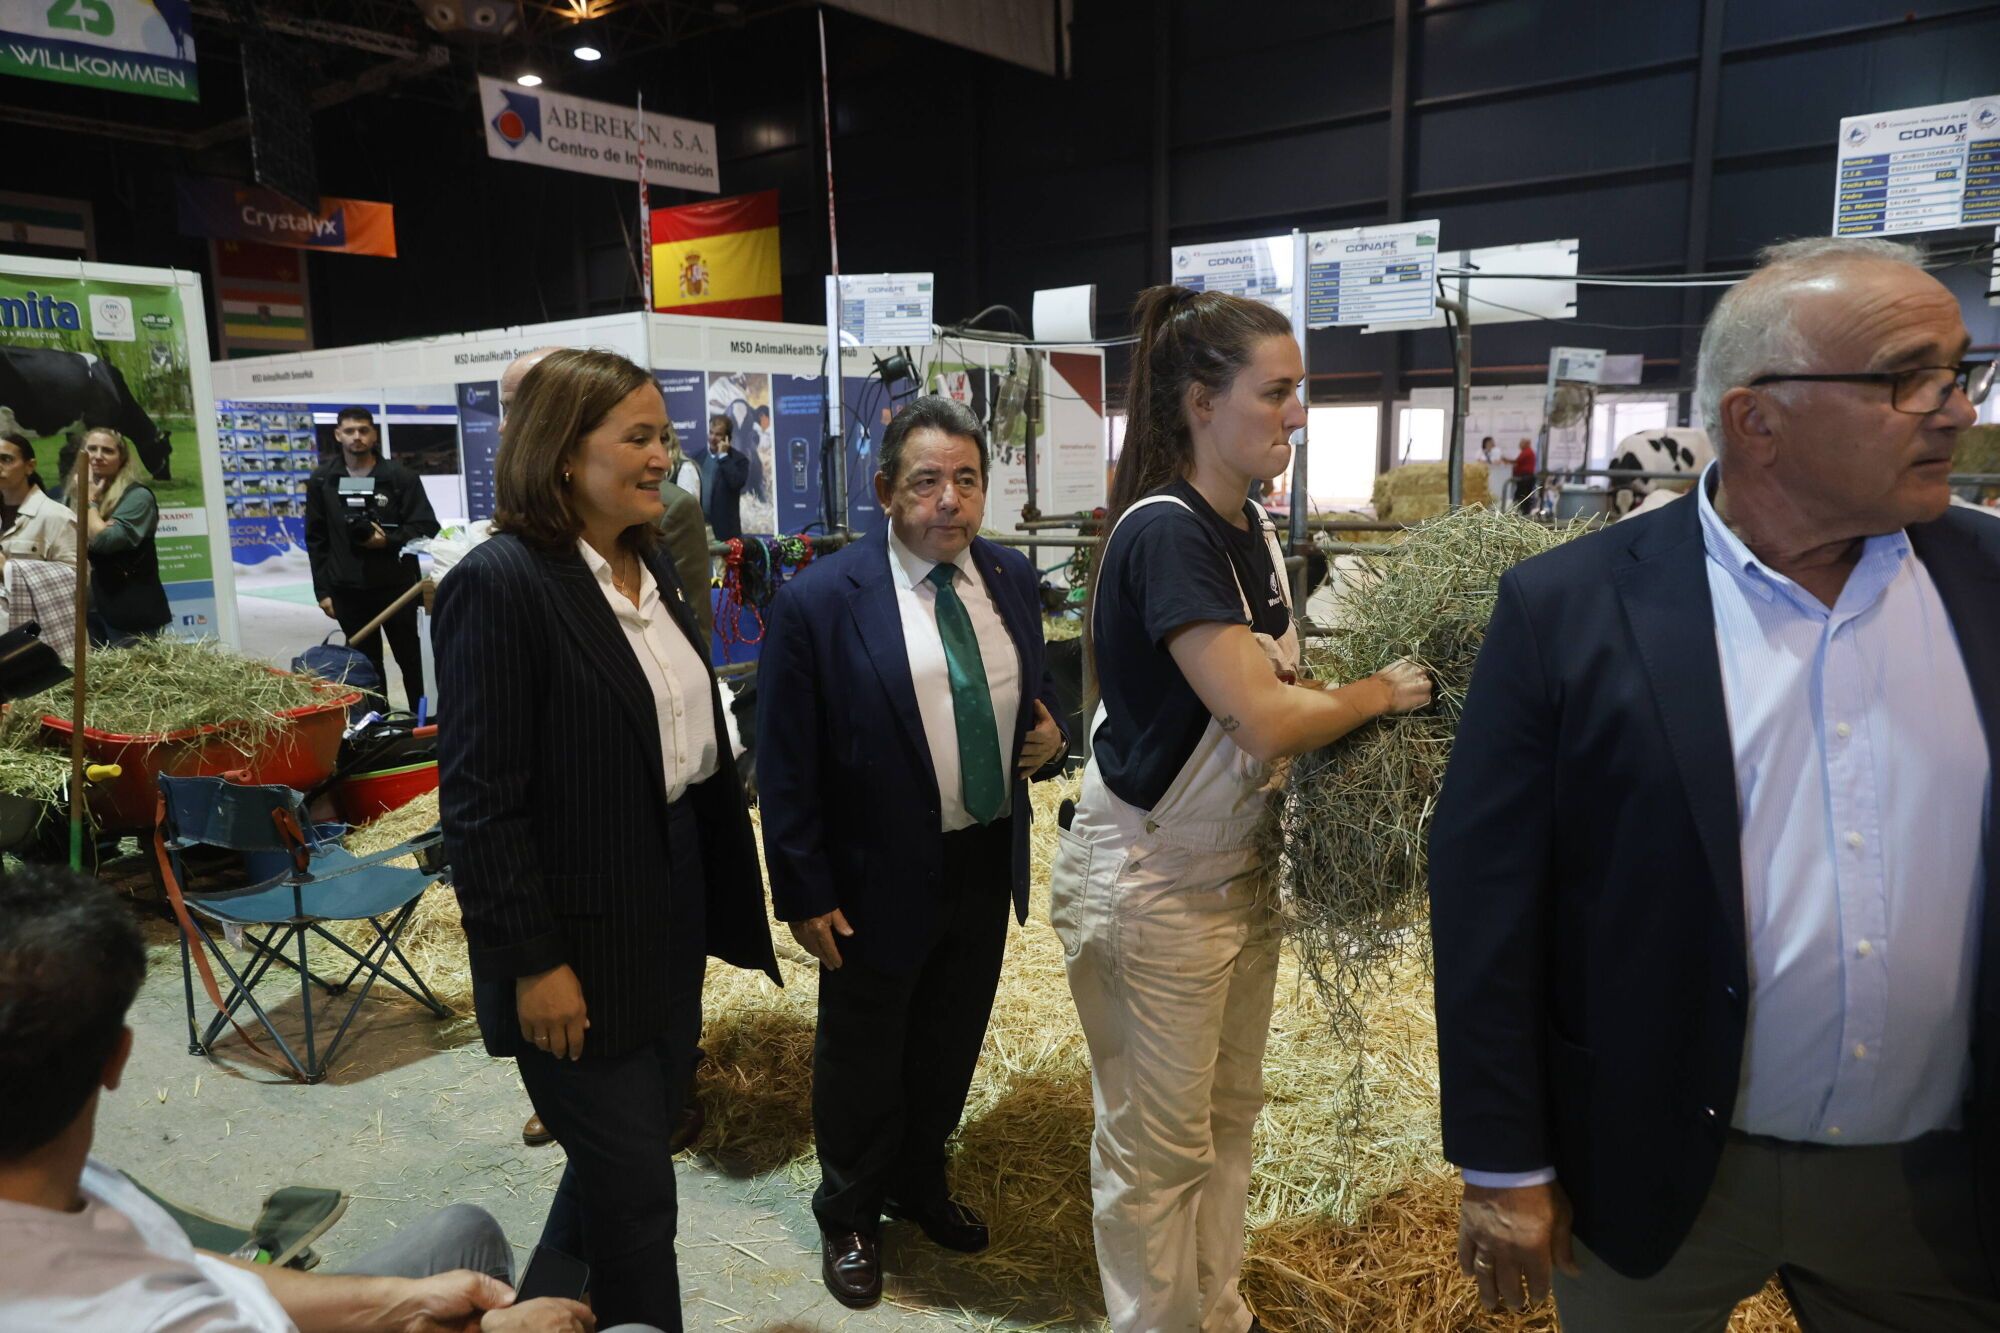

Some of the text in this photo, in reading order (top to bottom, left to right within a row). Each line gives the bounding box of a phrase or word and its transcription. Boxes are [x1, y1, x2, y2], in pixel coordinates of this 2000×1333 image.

[9, 44, 186, 88] WILLKOMMEN
[673, 130, 709, 154] S.A.
[548, 137, 713, 177] Centro de Ineminación
[242, 206, 337, 237] Crystalyx
[1345, 241, 1398, 254] CONAFE
[455, 353, 469, 365] MSD
[470, 346, 513, 363] AnimalHealth
[731, 341, 752, 353] MSD
[755, 342, 814, 356] AnimalHealth
[226, 401, 308, 411] NACIONALES
